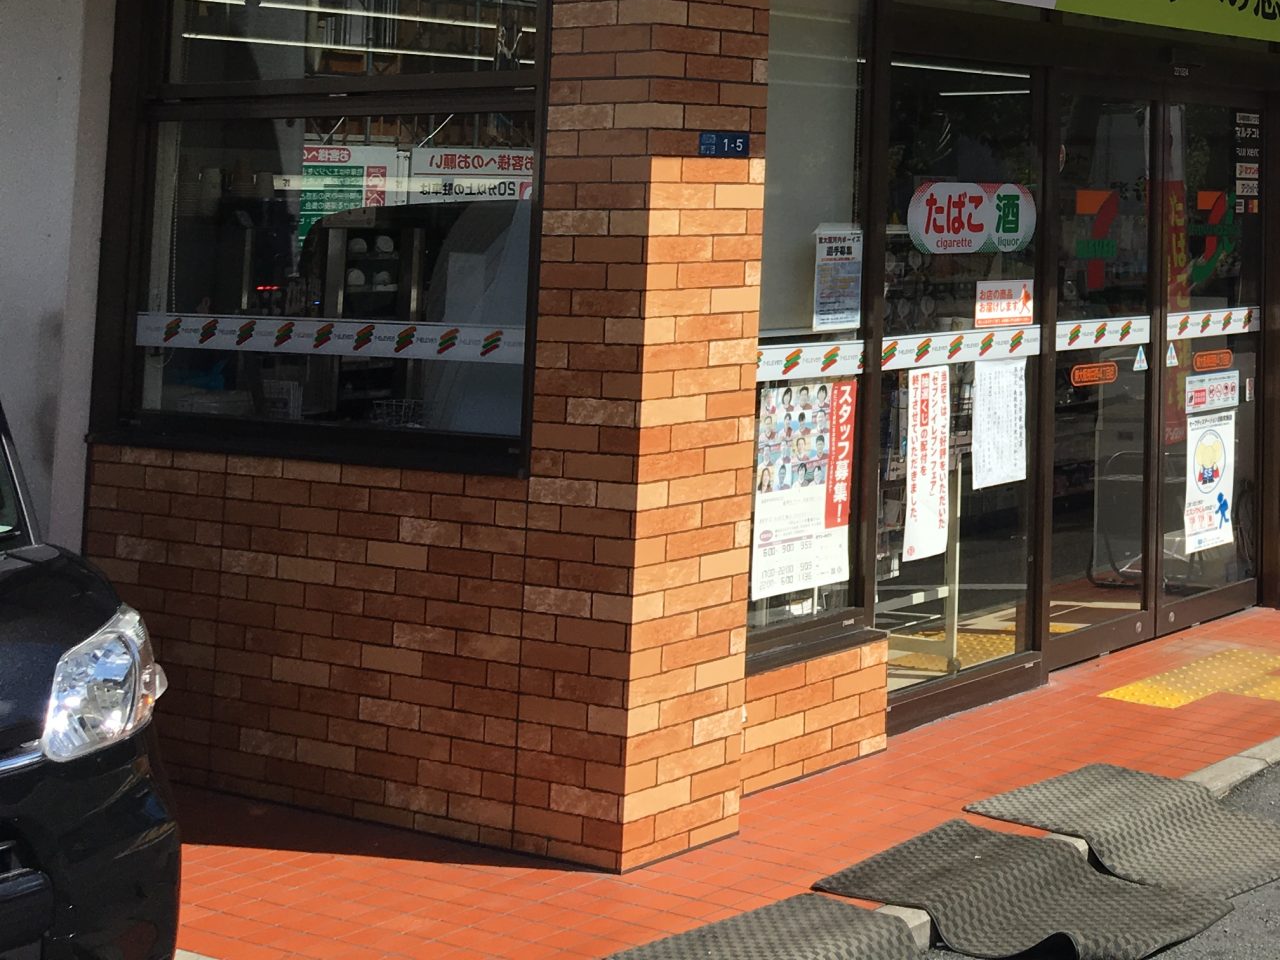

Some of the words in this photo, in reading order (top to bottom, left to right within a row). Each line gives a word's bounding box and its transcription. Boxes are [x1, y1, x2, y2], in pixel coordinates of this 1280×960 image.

[724, 138, 744, 152] 1-5
[925, 192, 984, 234] たばこ
[996, 193, 1020, 234] 酒
[936, 237, 972, 249] cigarette
[998, 237, 1020, 248] liquor
[826, 246, 853, 257] 選手募集
[979, 289, 1013, 300] お店の商品
[979, 301, 1018, 312] お届けします
[833, 385, 852, 522] スタッフ募集!
